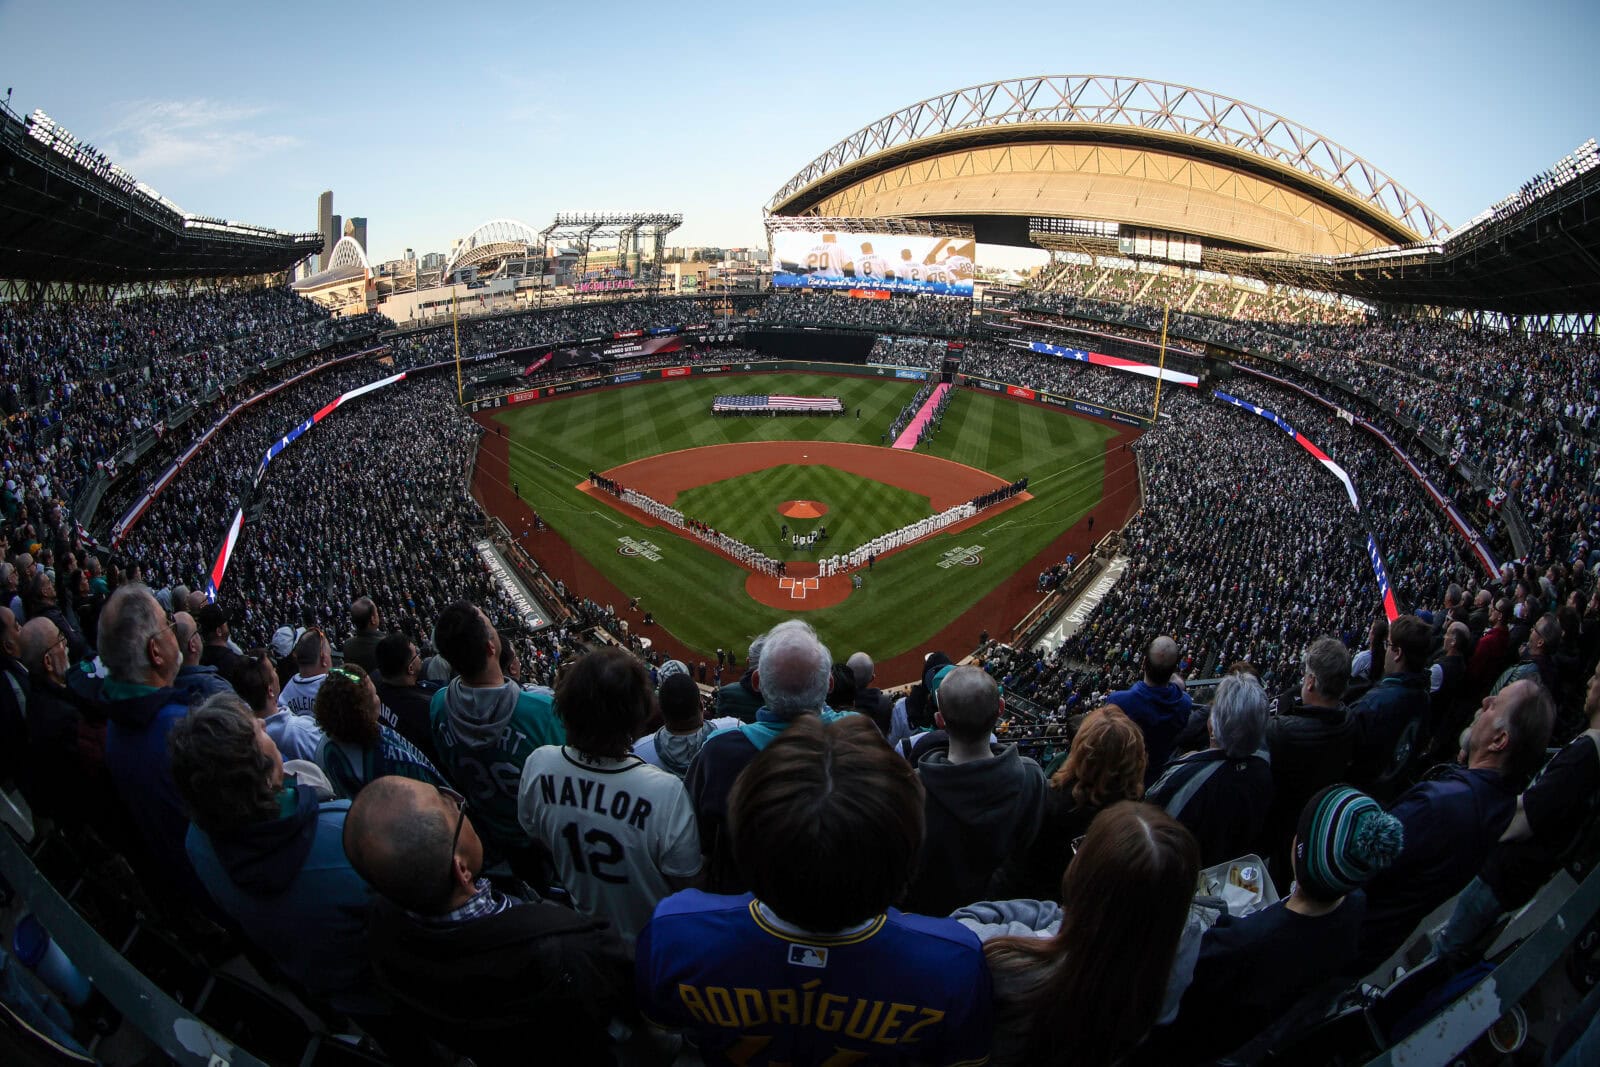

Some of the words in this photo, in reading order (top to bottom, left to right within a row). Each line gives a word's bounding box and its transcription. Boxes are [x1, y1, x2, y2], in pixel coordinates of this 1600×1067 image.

[808, 252, 828, 270] 20
[863, 261, 872, 275] 8
[960, 262, 972, 273] 88
[911, 268, 920, 281] 2
[612, 280, 634, 290] PARK
[516, 598, 532, 615] PARK
[288, 697, 316, 714] RALEI
[540, 774, 652, 831] NAYLOR
[562, 822, 629, 884] 12
[678, 978, 945, 1045] RODRÍGUEZ
